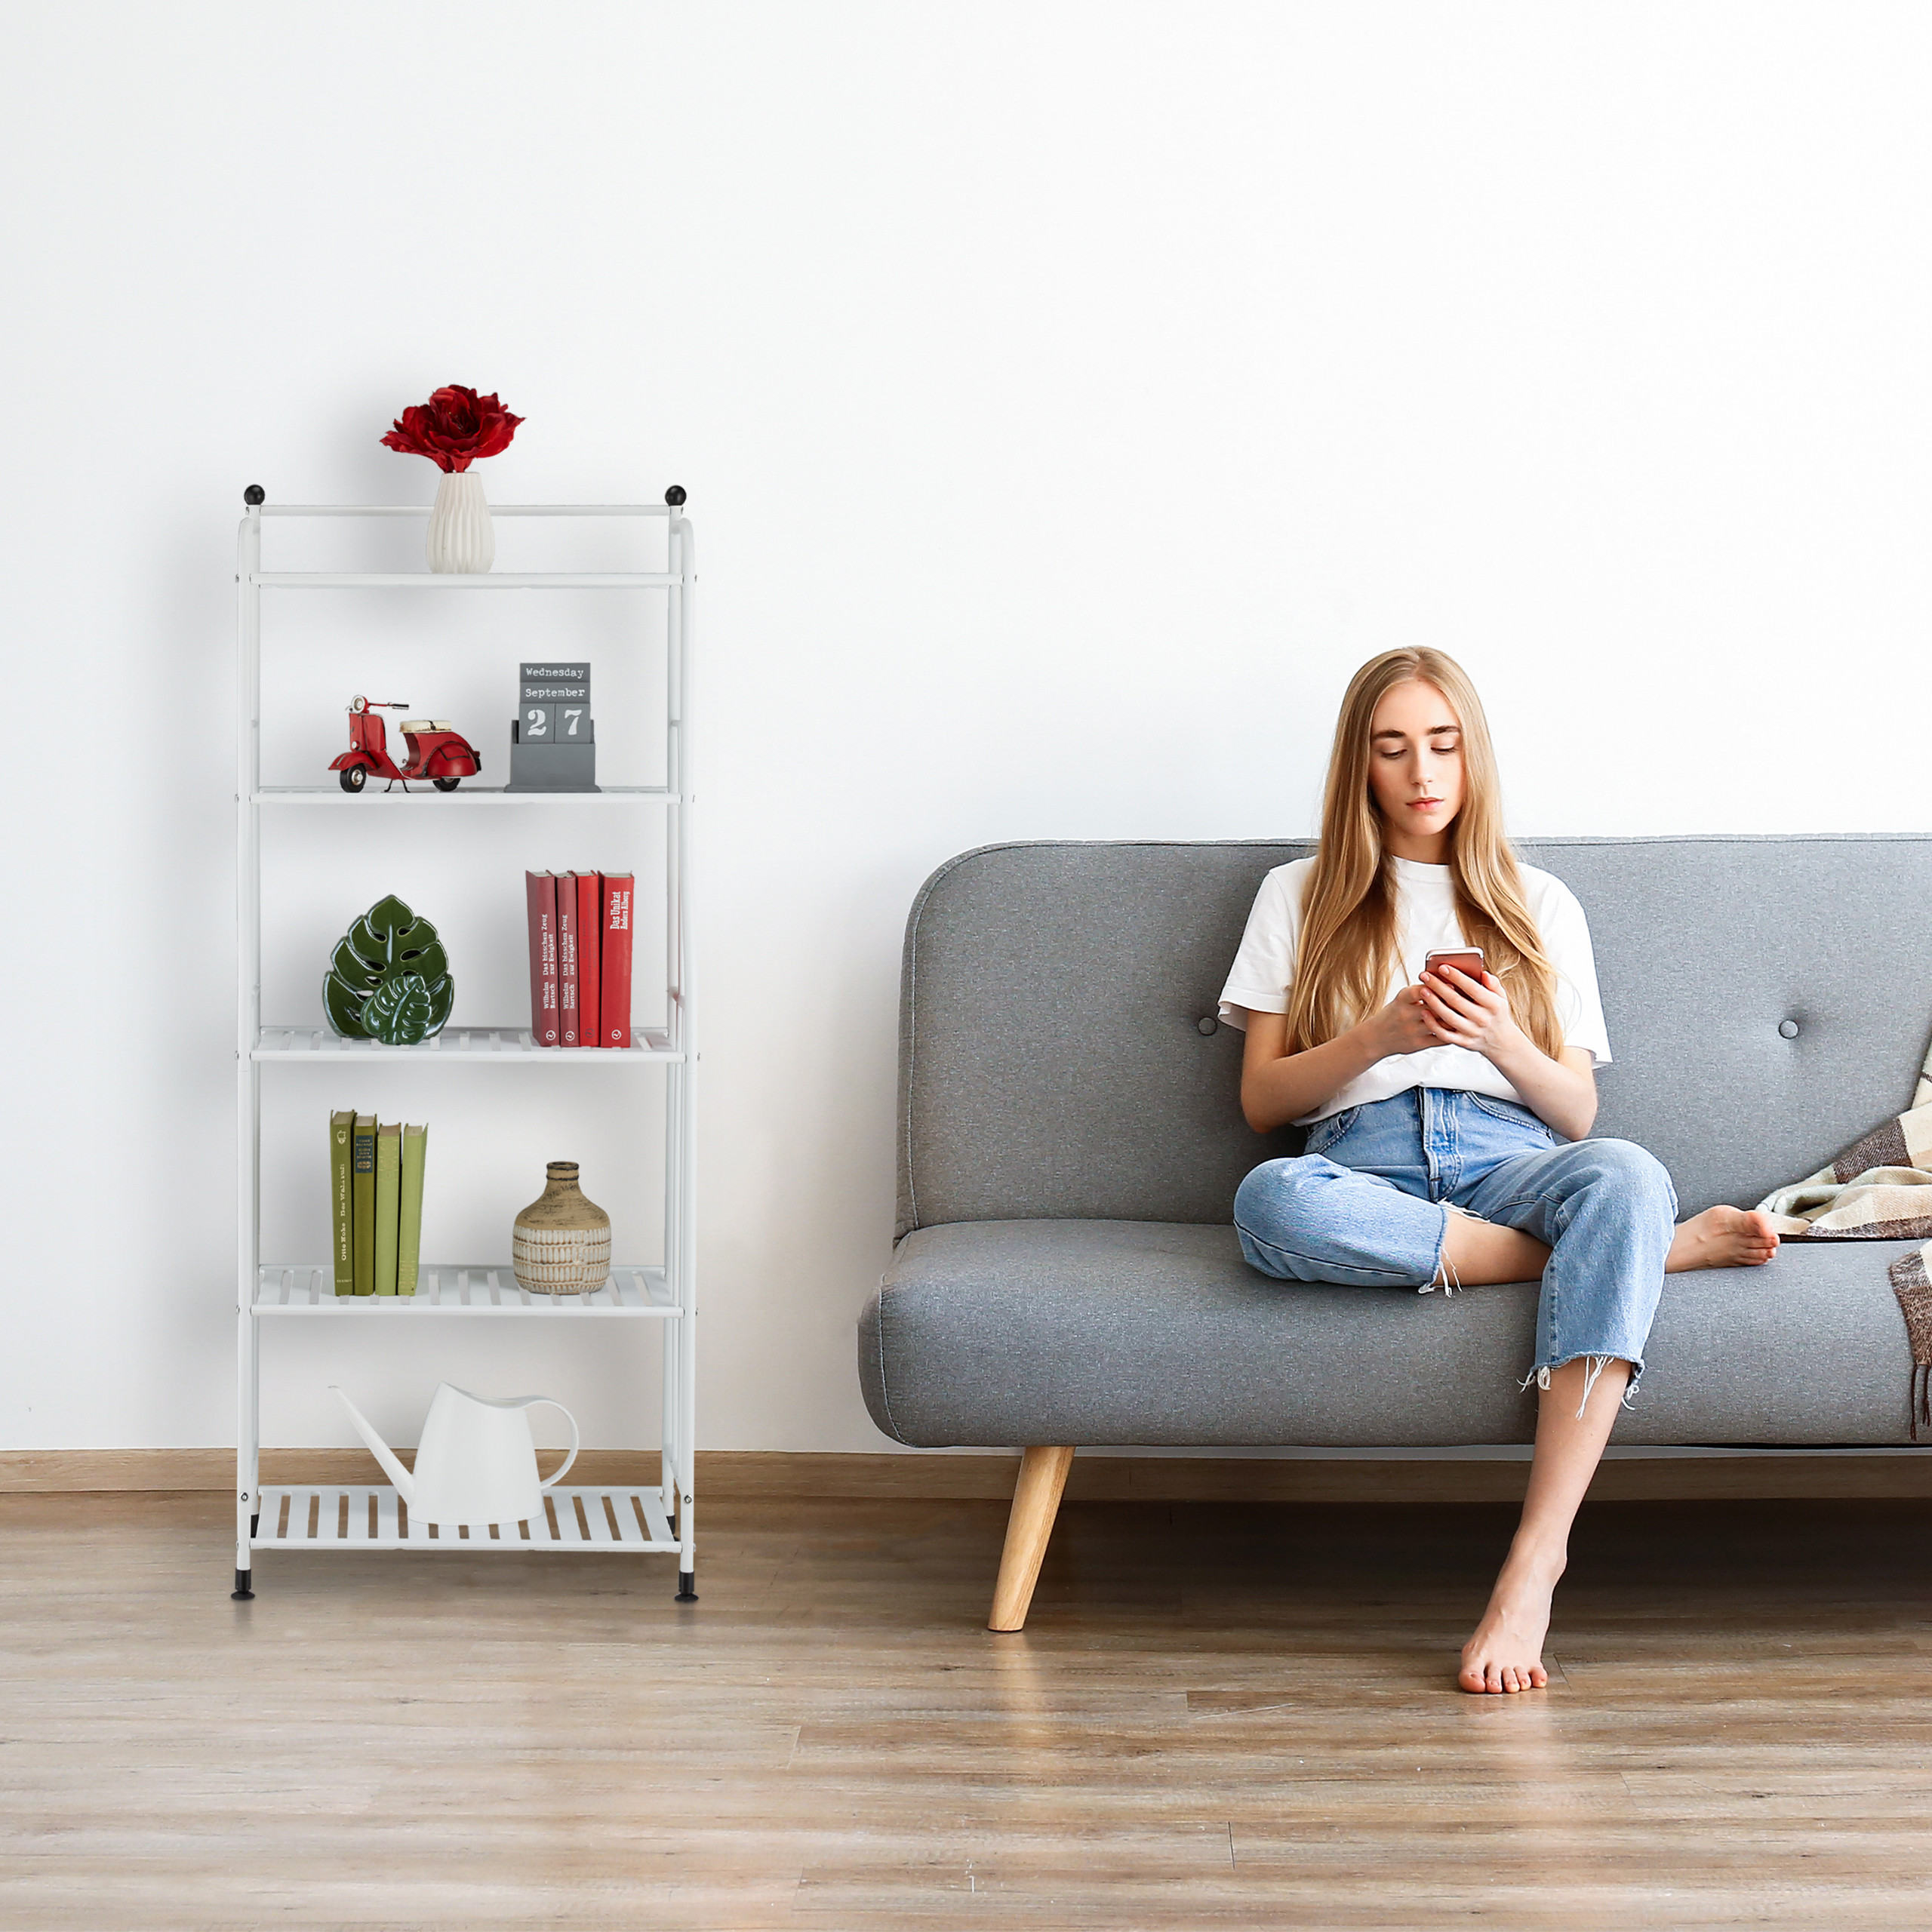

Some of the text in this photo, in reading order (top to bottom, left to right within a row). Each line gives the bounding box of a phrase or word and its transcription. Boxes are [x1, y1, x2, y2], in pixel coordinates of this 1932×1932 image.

[526, 668, 584, 679] Wednesday
[525, 688, 585, 698] September
[528, 709, 582, 736] 2 7
[610, 891, 621, 930] Das Unikat
